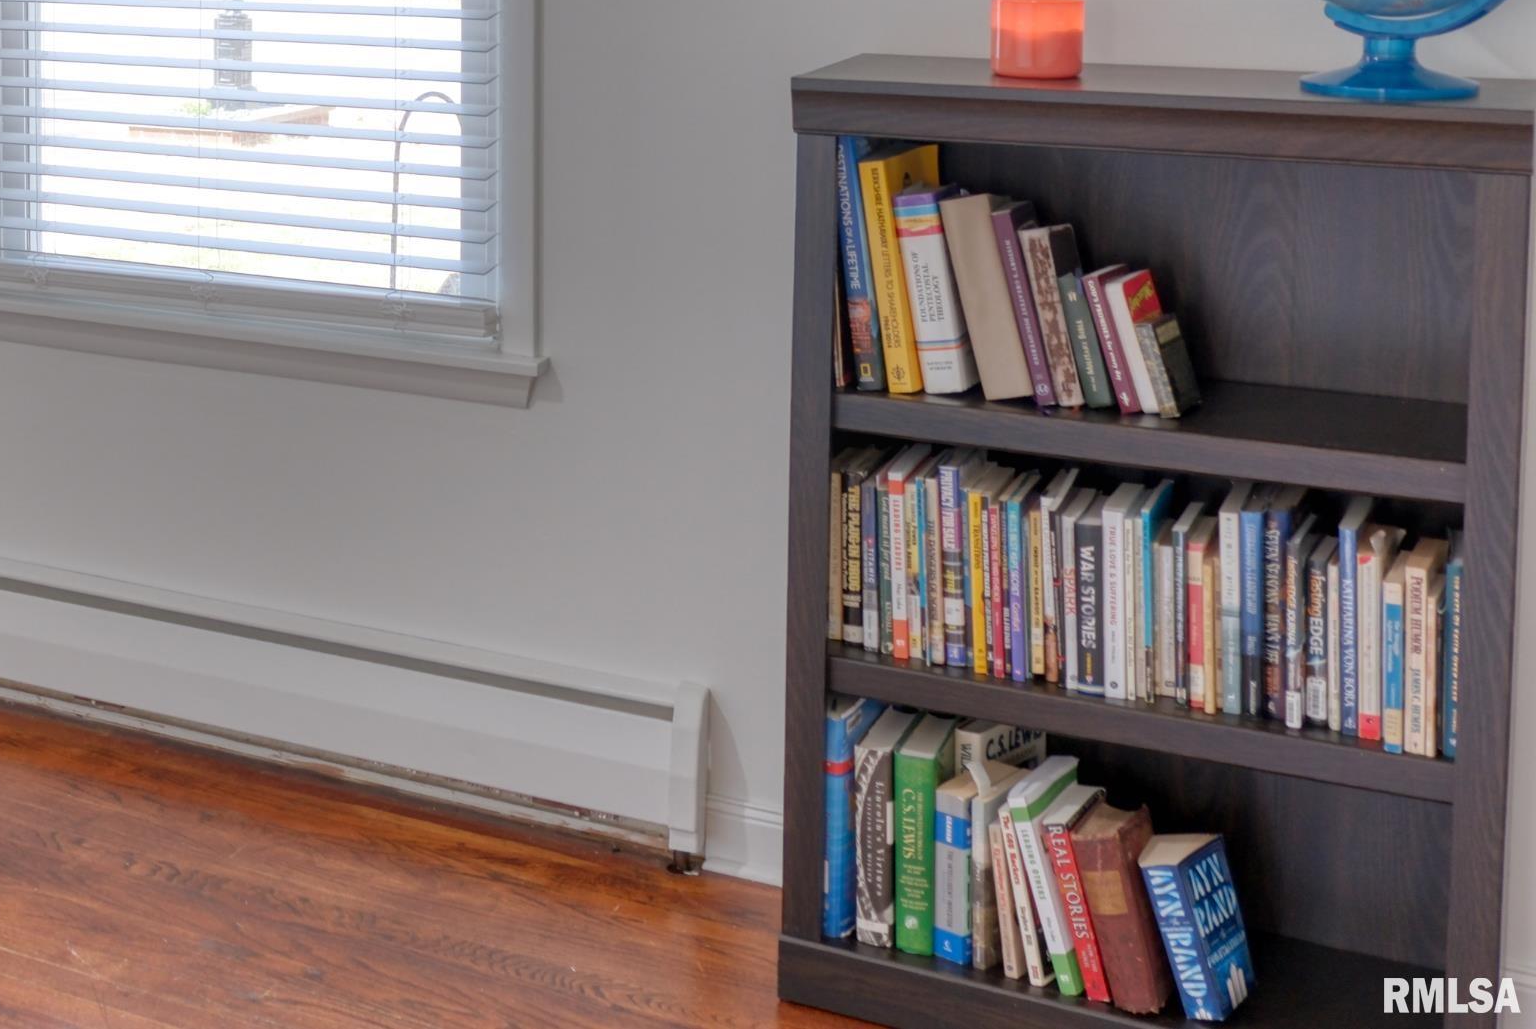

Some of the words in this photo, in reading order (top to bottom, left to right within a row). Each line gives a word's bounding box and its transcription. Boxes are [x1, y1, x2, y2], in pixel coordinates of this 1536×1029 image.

[873, 167, 883, 206] BERKSHIRE
[877, 208, 889, 250] HATHAWAY
[846, 247, 862, 292] LIFETIME
[883, 250, 892, 278] LETTERS
[910, 251, 920, 264] OF
[885, 279, 894, 291] TO
[913, 267, 929, 323] FOUNDATIONS
[921, 263, 937, 323] PENTECOSTAL
[931, 275, 946, 322] THEOLOGY
[889, 291, 903, 350] SHAREHOLDERS
[848, 485, 861, 511] THE
[881, 496, 891, 515] God
[941, 470, 955, 508] PRIVACY
[882, 516, 890, 541] meant
[893, 498, 902, 534] LEADING
[926, 520, 936, 536] THE
[945, 510, 957, 526] FOR
[895, 536, 903, 572] LEADERS
[946, 527, 958, 550] SALE
[1109, 526, 1118, 547] TRUE
[1265, 529, 1281, 560] SEVEN
[849, 558, 861, 593] DRUG
[867, 547, 875, 583] TITANIC
[927, 538, 937, 581] DANGERS
[1080, 545, 1095, 581] WAR
[1110, 549, 1118, 569] LOVE
[1012, 570, 1022, 596] SECRET
[1064, 567, 1076, 616] SPARK
[1266, 562, 1281, 605] SEASONS
[1410, 575, 1425, 615] PODIUM
[1081, 585, 1097, 649] STORIES
[1109, 581, 1119, 626] SUFFERING
[1342, 580, 1355, 636] KATHARINA
[1267, 614, 1282, 643] MAN'S
[1410, 618, 1424, 655] HUMOR
[1268, 644, 1281, 665] LIFE
[1343, 639, 1355, 664] VON
[1344, 666, 1356, 708] BORA
[1409, 666, 1422, 695] JAMES
[1411, 703, 1422, 735] HUMES
[874, 780, 886, 842] Lincoln's
[1003, 815, 1014, 830] The
[902, 818, 917, 860] LEWIS
[875, 848, 886, 898] Virtues
[1020, 829, 1036, 865] LEADING
[1031, 868, 1047, 901] OTHERS
[1047, 825, 1069, 869] REAL
[1059, 872, 1092, 940] STORIES
[1188, 852, 1226, 902] AYN
[1147, 868, 1186, 919] AYN
[1193, 884, 1238, 939] RAND
[1165, 932, 1209, 999] RAND
